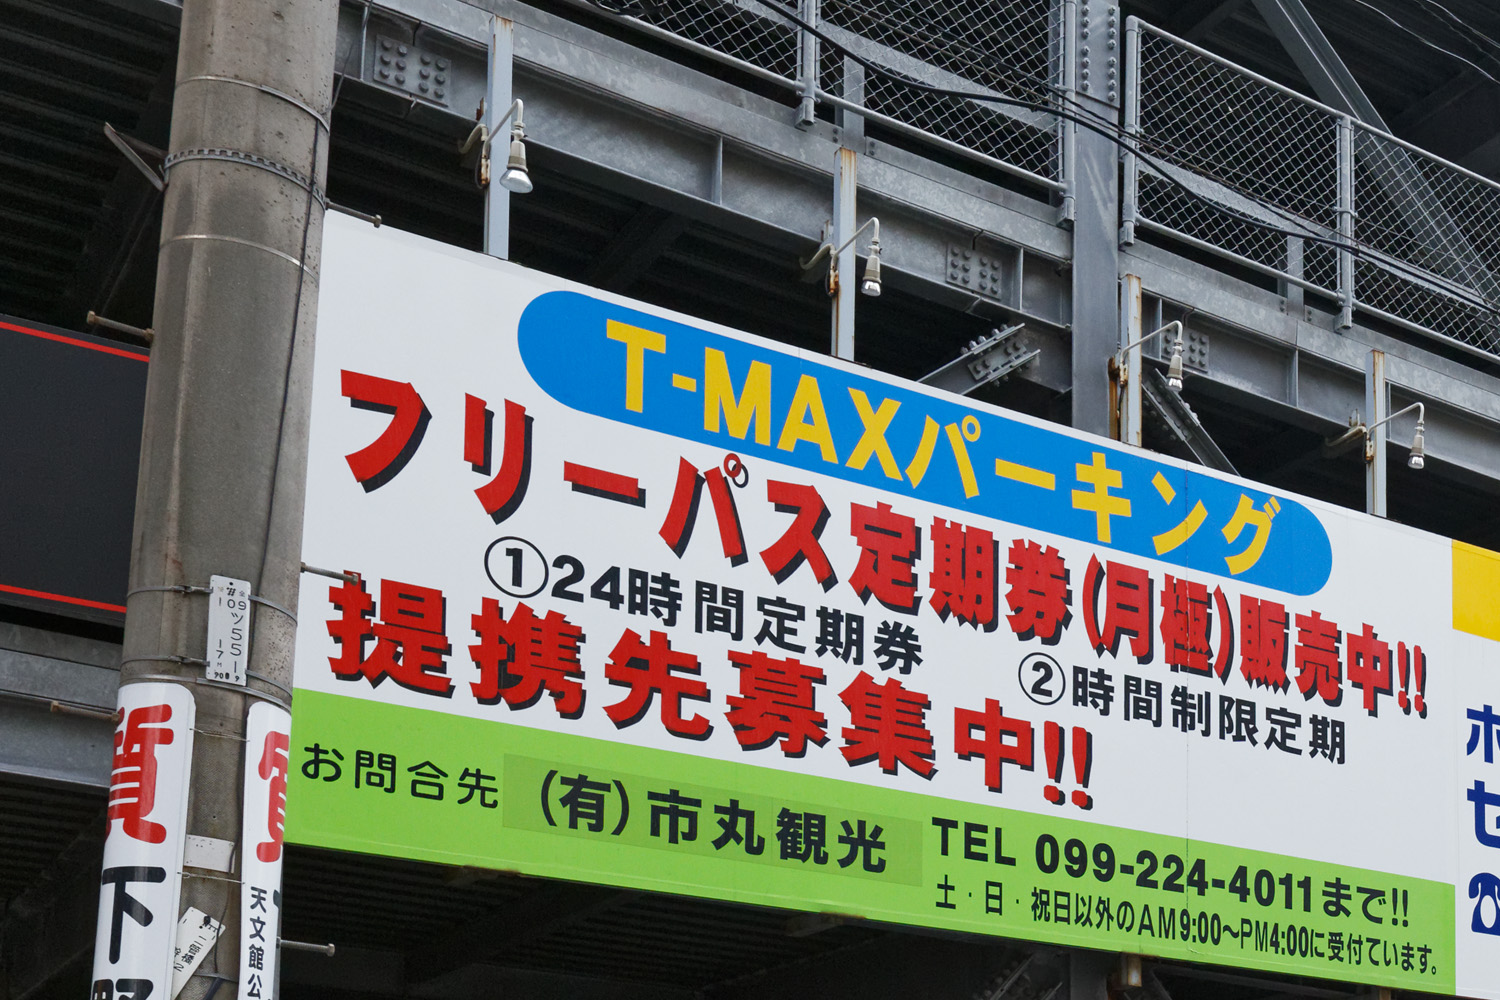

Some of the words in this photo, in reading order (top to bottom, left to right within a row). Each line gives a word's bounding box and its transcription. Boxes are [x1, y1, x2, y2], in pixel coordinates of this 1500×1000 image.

[606, 319, 1282, 576] T-MAXパーキング
[325, 571, 1093, 810] 提携先募集中!!
[301, 743, 499, 809] お問合先
[540, 769, 887, 874] (有)市丸観光
[931, 817, 1016, 866] TEL
